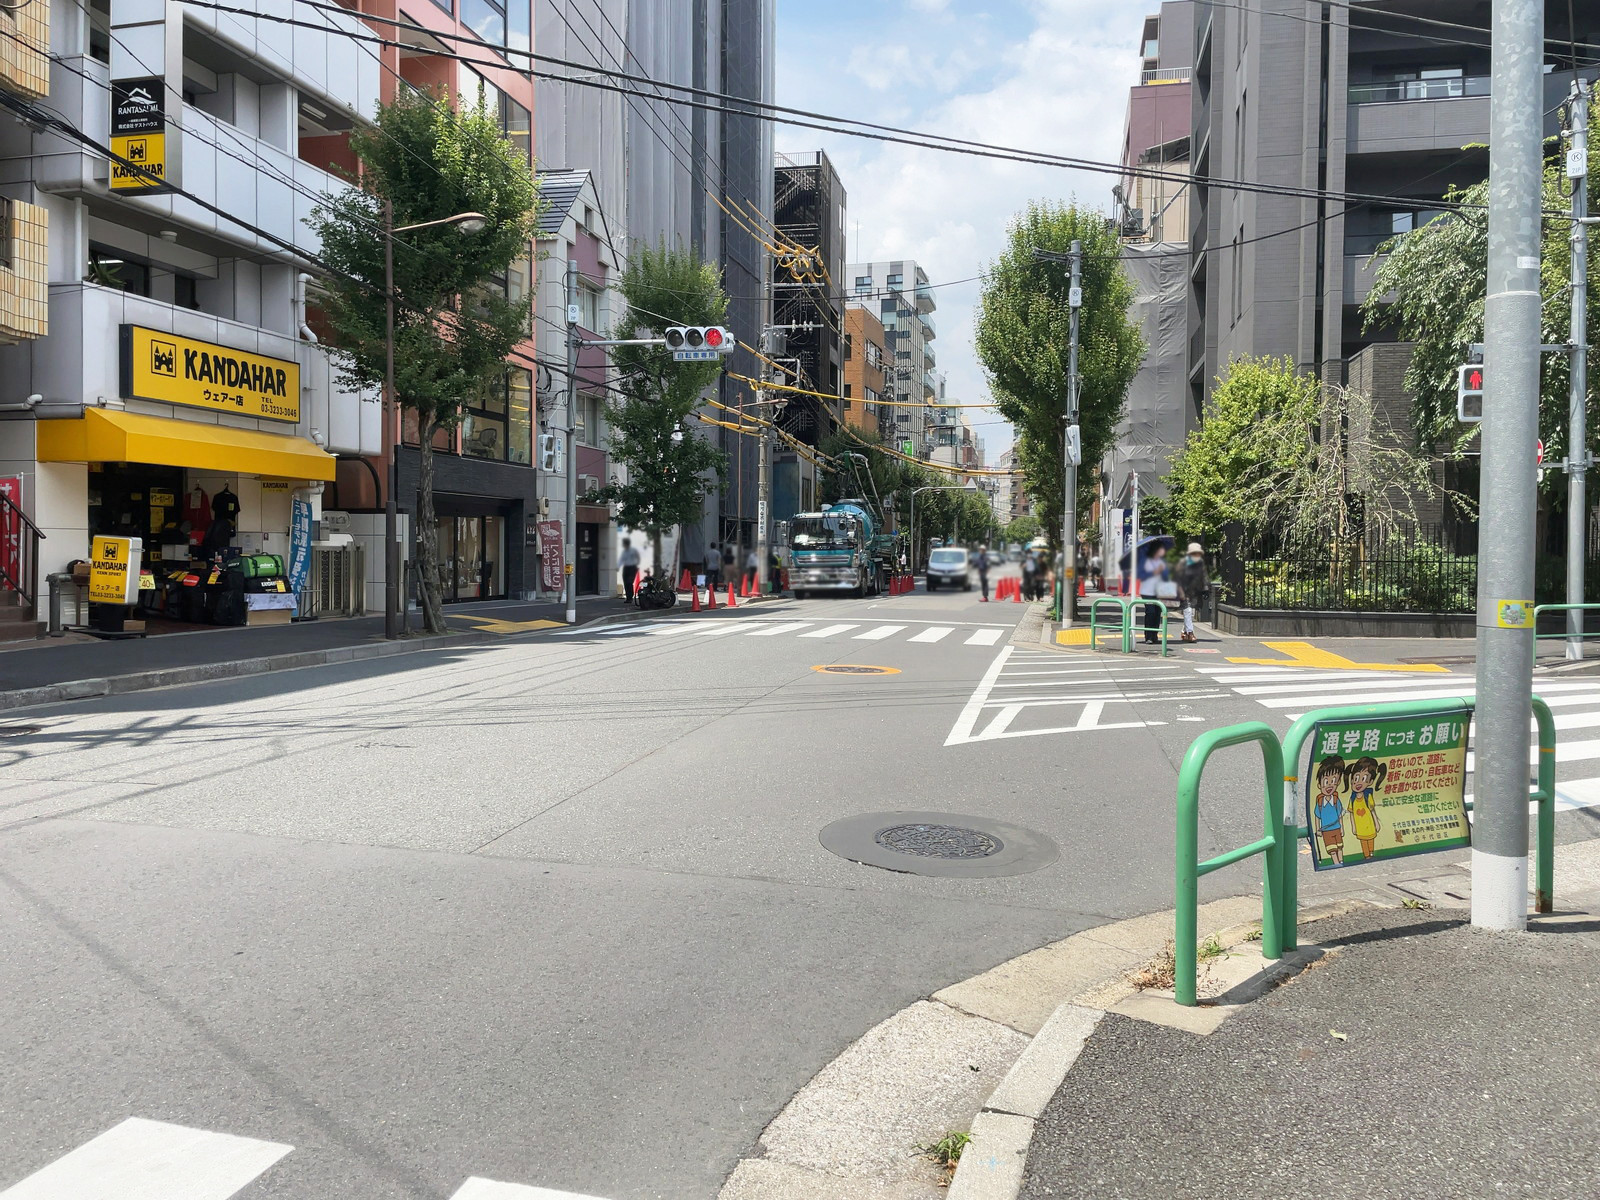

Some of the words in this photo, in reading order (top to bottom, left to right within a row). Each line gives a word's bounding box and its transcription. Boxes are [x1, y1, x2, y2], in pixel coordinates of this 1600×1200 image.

[113, 163, 163, 178] KANHAR
[184, 348, 287, 397] KANDAHAR
[203, 389, 244, 406] ウェアー店
[92, 561, 127, 571] KANDAHAR
[1320, 728, 1380, 755] 通学路
[1385, 730, 1416, 747] につき
[1418, 722, 1464, 746] お願い
[1388, 753, 1447, 769] 危ないので、道路に
[1386, 763, 1461, 782] 看板・のぼり・自転車など
[1384, 776, 1458, 794] 物を置かないでください
[1417, 801, 1460, 814] ご協力ください
